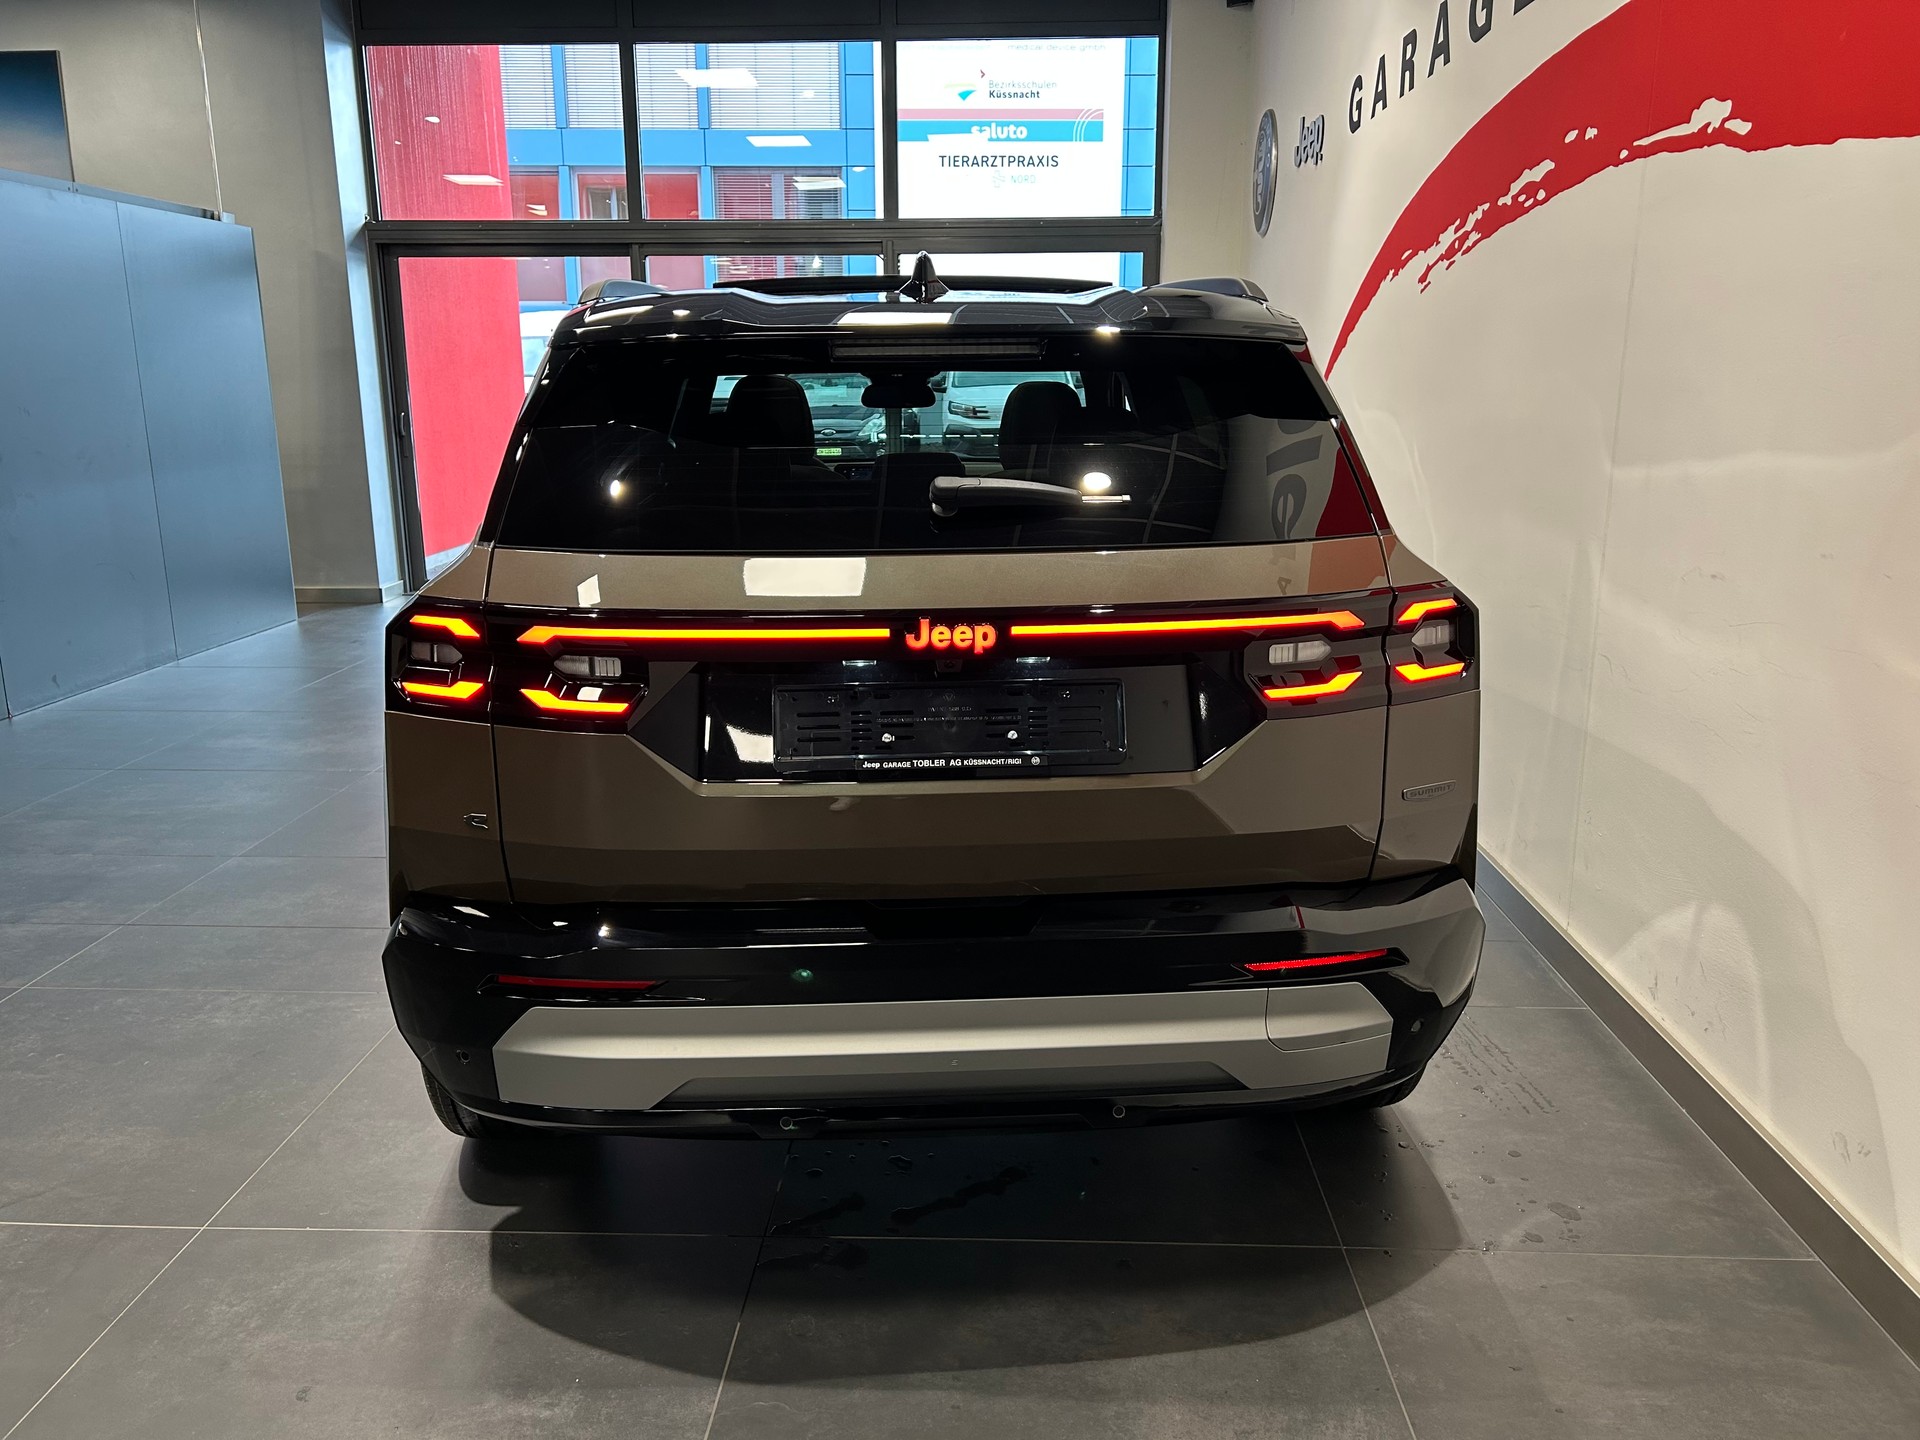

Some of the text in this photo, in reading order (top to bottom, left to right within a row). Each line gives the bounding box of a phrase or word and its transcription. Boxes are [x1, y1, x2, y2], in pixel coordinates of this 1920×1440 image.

[988, 79, 1057, 89] Bezirksschulen
[1294, 0, 1535, 168] Jeep GARAG
[988, 89, 1041, 99] Küssnacht
[970, 122, 1028, 139] saluto
[939, 155, 1059, 168] TIERARZTPRAXIS
[1010, 175, 1037, 184] NORD
[905, 617, 997, 654] Jeep
[862, 761, 880, 769] Jeep
[913, 759, 946, 767] TOBLER
[964, 758, 1022, 766] KÜSSNACHT/RIGI
[1409, 784, 1452, 797] SUMMIT
